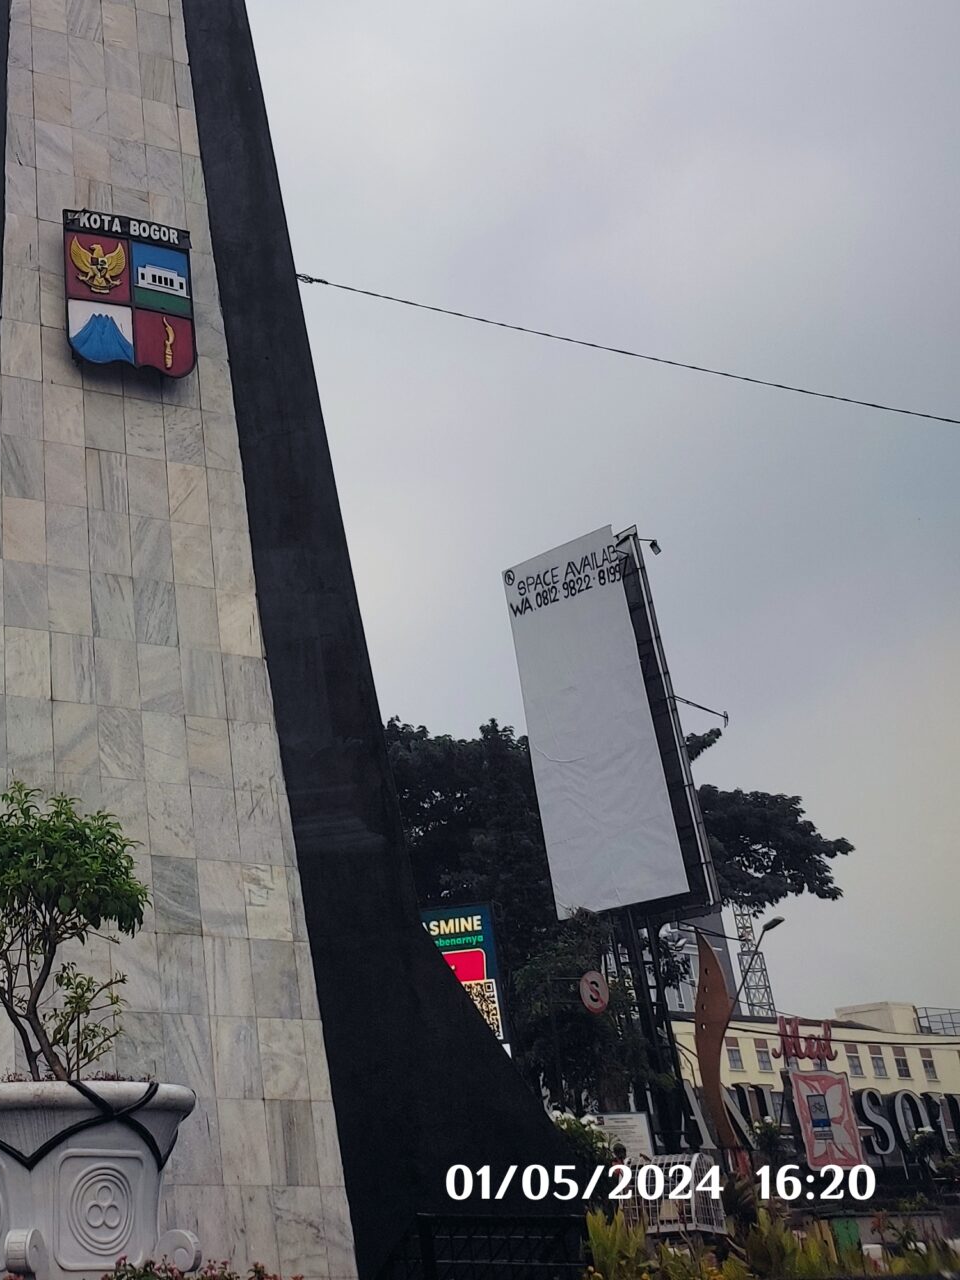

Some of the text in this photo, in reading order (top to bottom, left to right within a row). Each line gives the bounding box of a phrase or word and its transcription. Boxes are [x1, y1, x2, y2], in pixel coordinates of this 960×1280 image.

[79, 211, 179, 245] KOTA BOGOR
[517, 566, 560, 596] SPACE
[422, 915, 482, 936] SMINE
